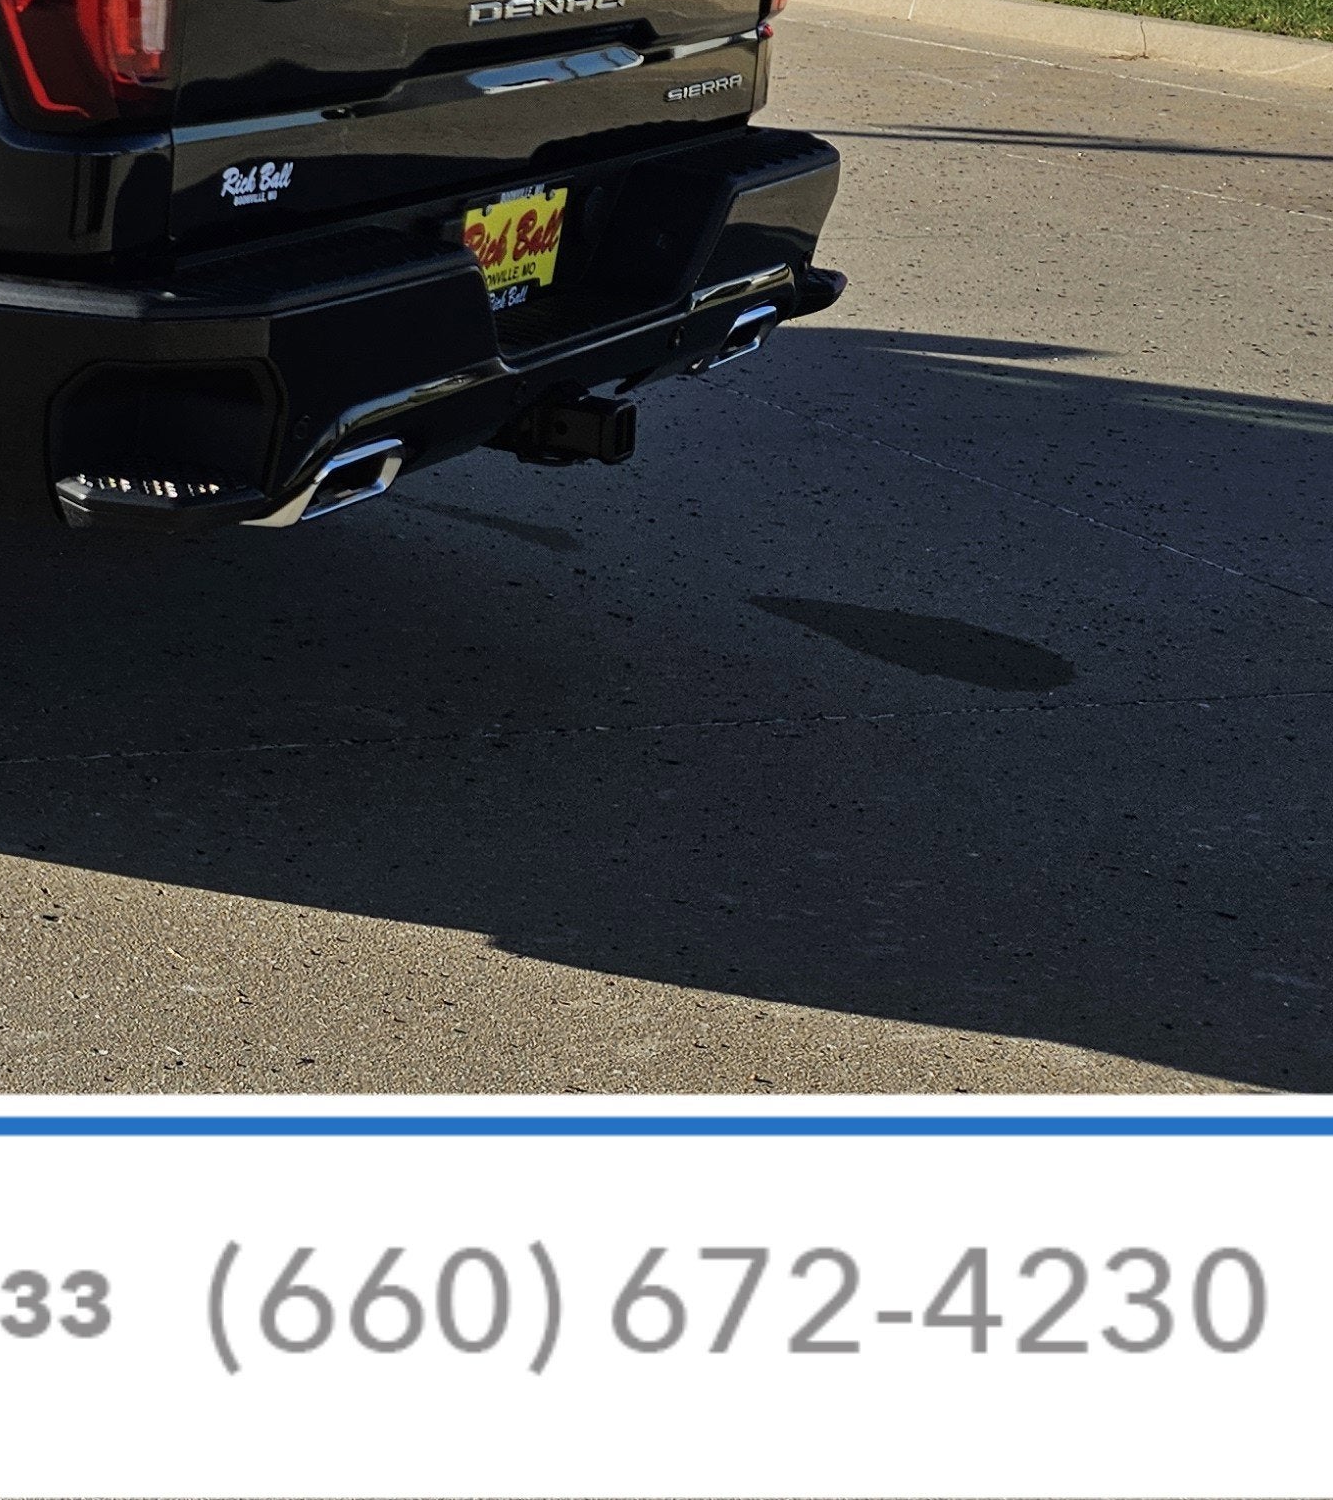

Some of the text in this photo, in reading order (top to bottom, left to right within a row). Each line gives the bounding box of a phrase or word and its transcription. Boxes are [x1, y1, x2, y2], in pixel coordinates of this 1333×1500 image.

[664, 73, 744, 101] SIERRA
[220, 161, 294, 197] Rick Ball
[512, 208, 565, 262] Ball
